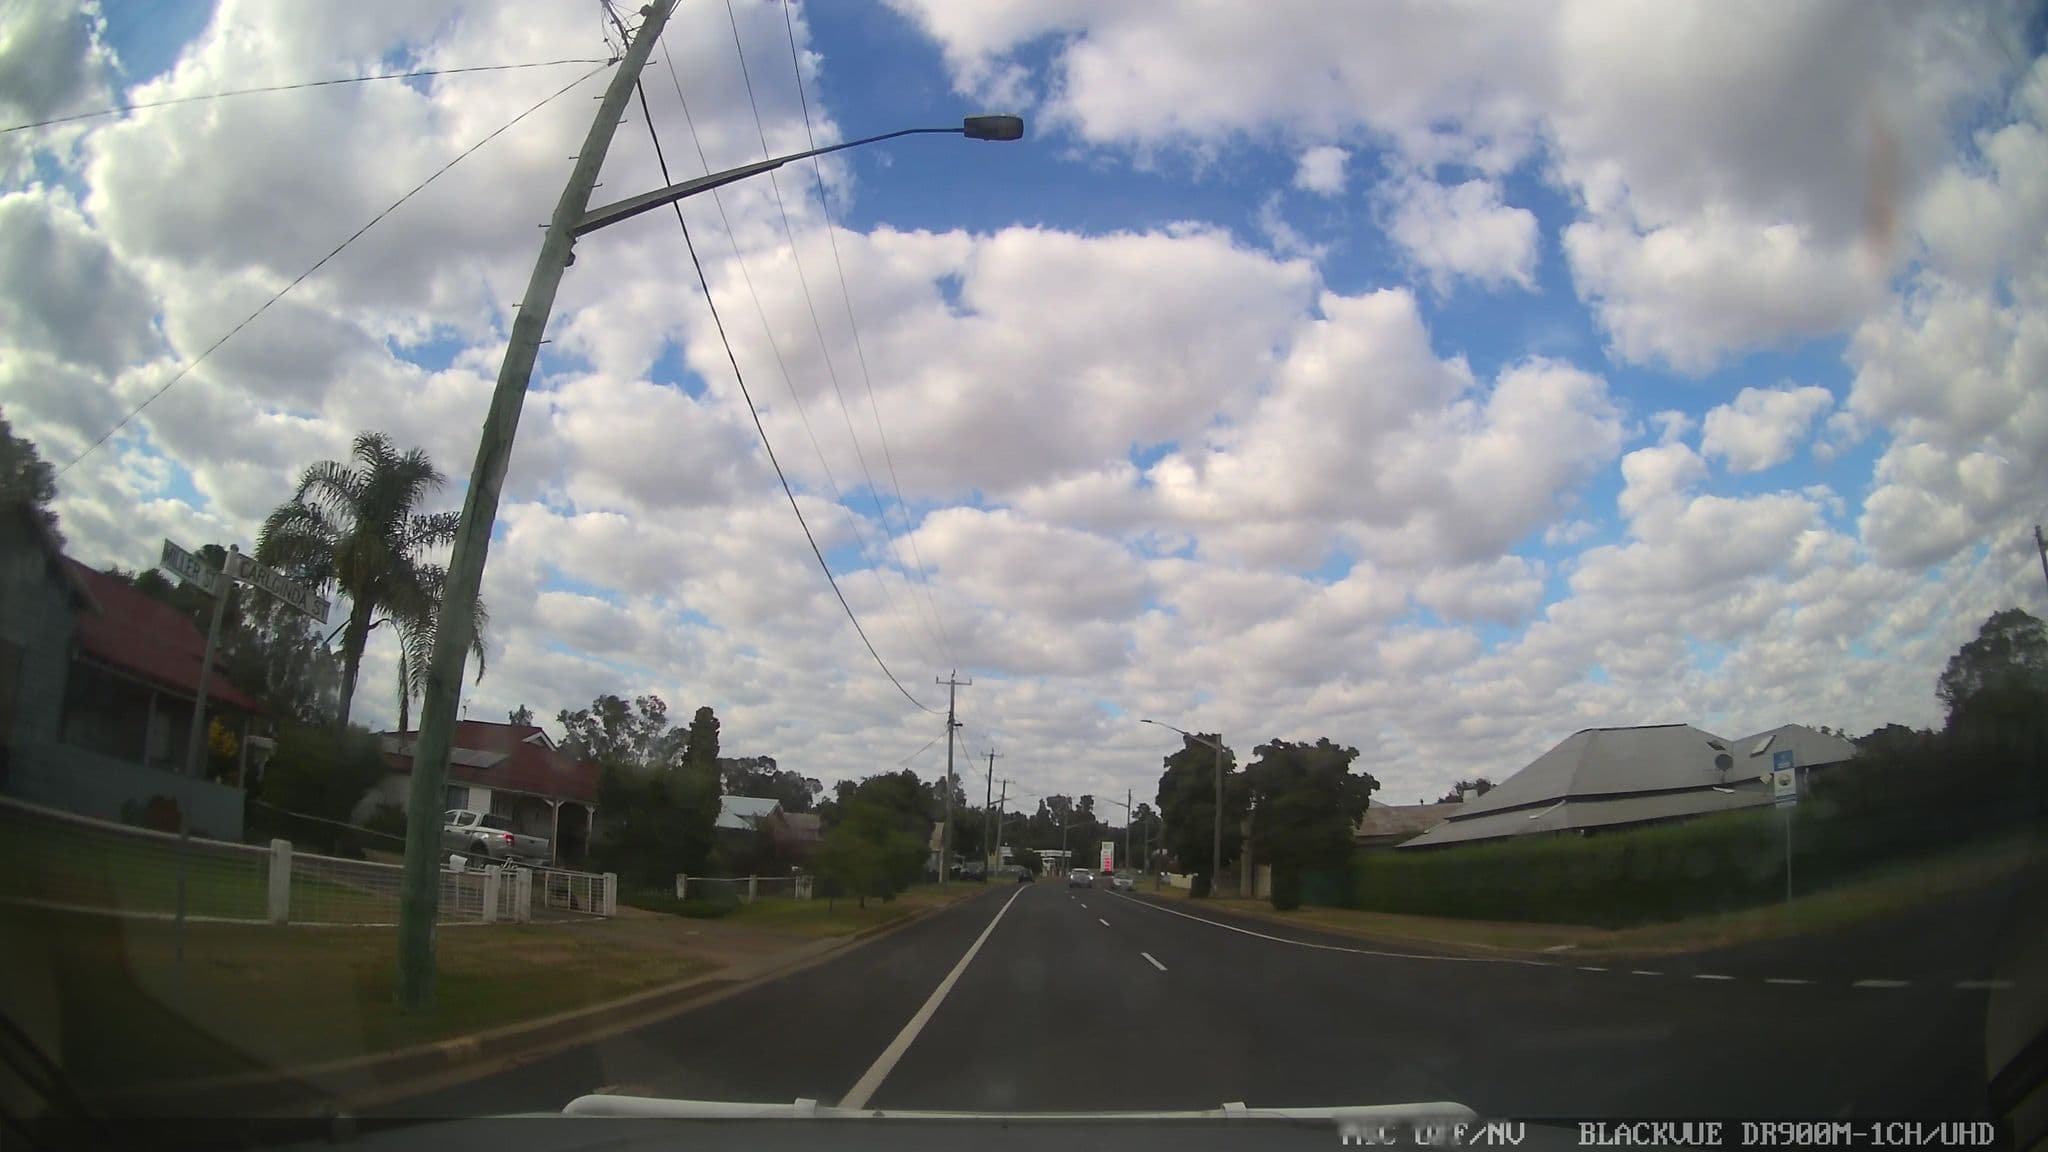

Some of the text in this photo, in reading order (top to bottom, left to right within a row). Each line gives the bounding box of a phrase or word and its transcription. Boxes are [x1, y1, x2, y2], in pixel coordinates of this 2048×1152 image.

[165, 544, 217, 590] MILLER ST
[241, 560, 328, 620] CARLGINDA ST
